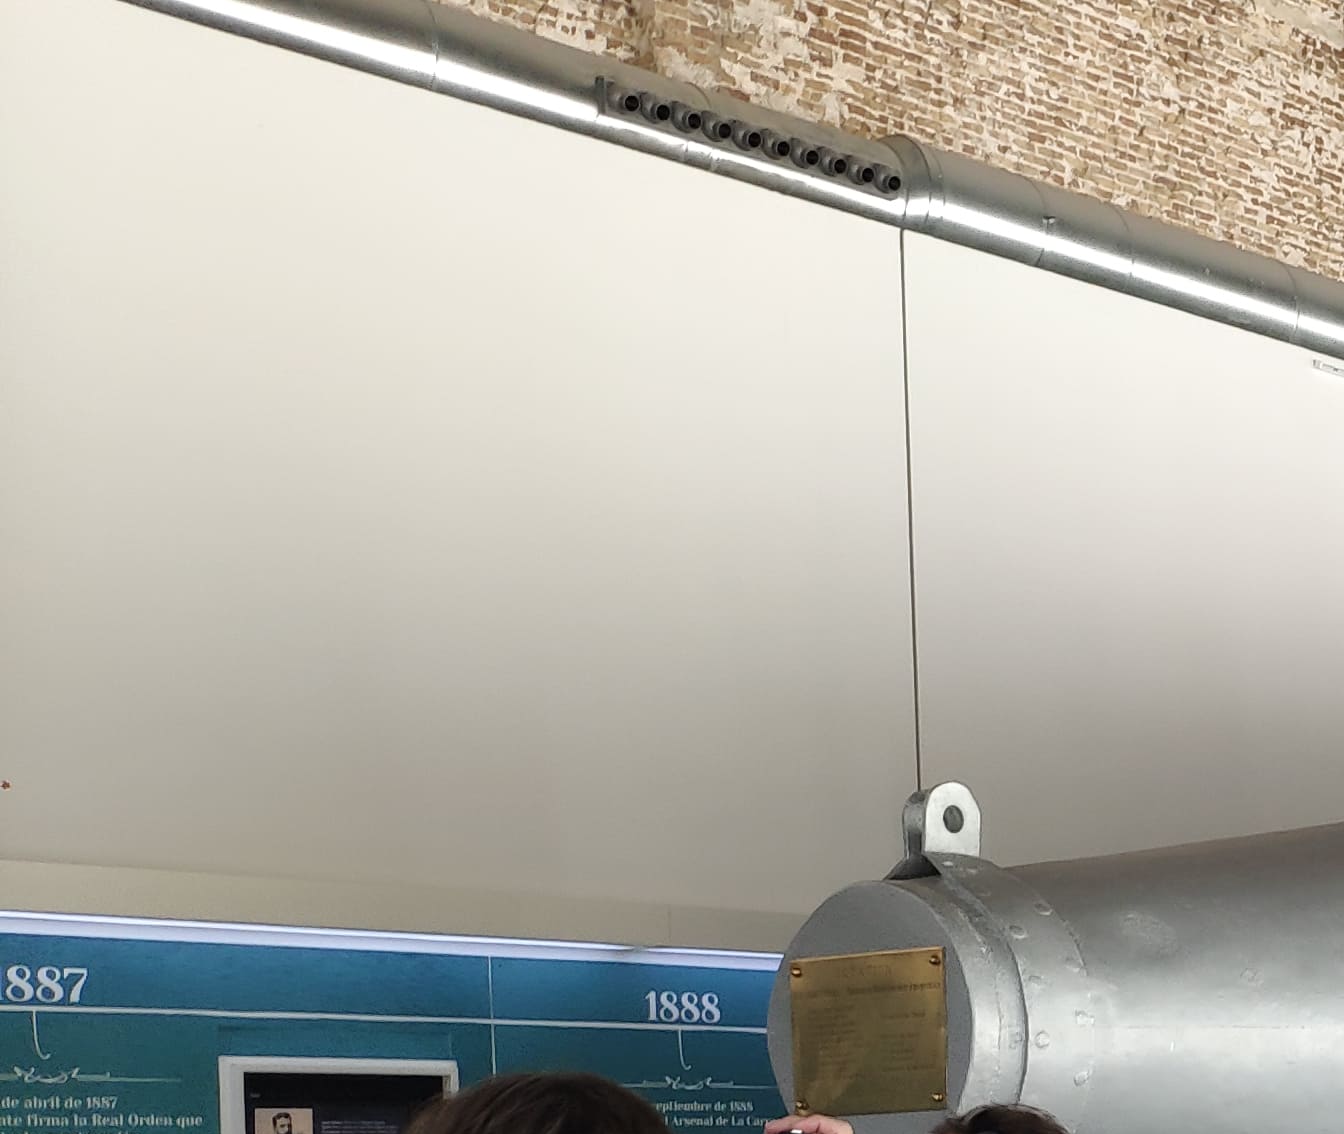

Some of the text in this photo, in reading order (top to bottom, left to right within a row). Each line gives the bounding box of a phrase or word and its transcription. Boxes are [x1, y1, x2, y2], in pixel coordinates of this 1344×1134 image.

[0, 964, 88, 1003] 887
[645, 990, 721, 1024] 1888
[24, 1096, 60, 1109] abril
[64, 1096, 82, 1109] de
[86, 1096, 117, 1109] 1887
[655, 1101, 753, 1113] eptiembre de 1888
[27, 1114, 70, 1127] firma
[73, 1114, 88, 1127] la
[92, 1114, 124, 1127] Real
[128, 1114, 173, 1127] Orden
[176, 1116, 203, 1130] que
[673, 1115, 714, 1127] Arsenal
[716, 1116, 729, 1126] de
[732, 1115, 743, 1126] La
